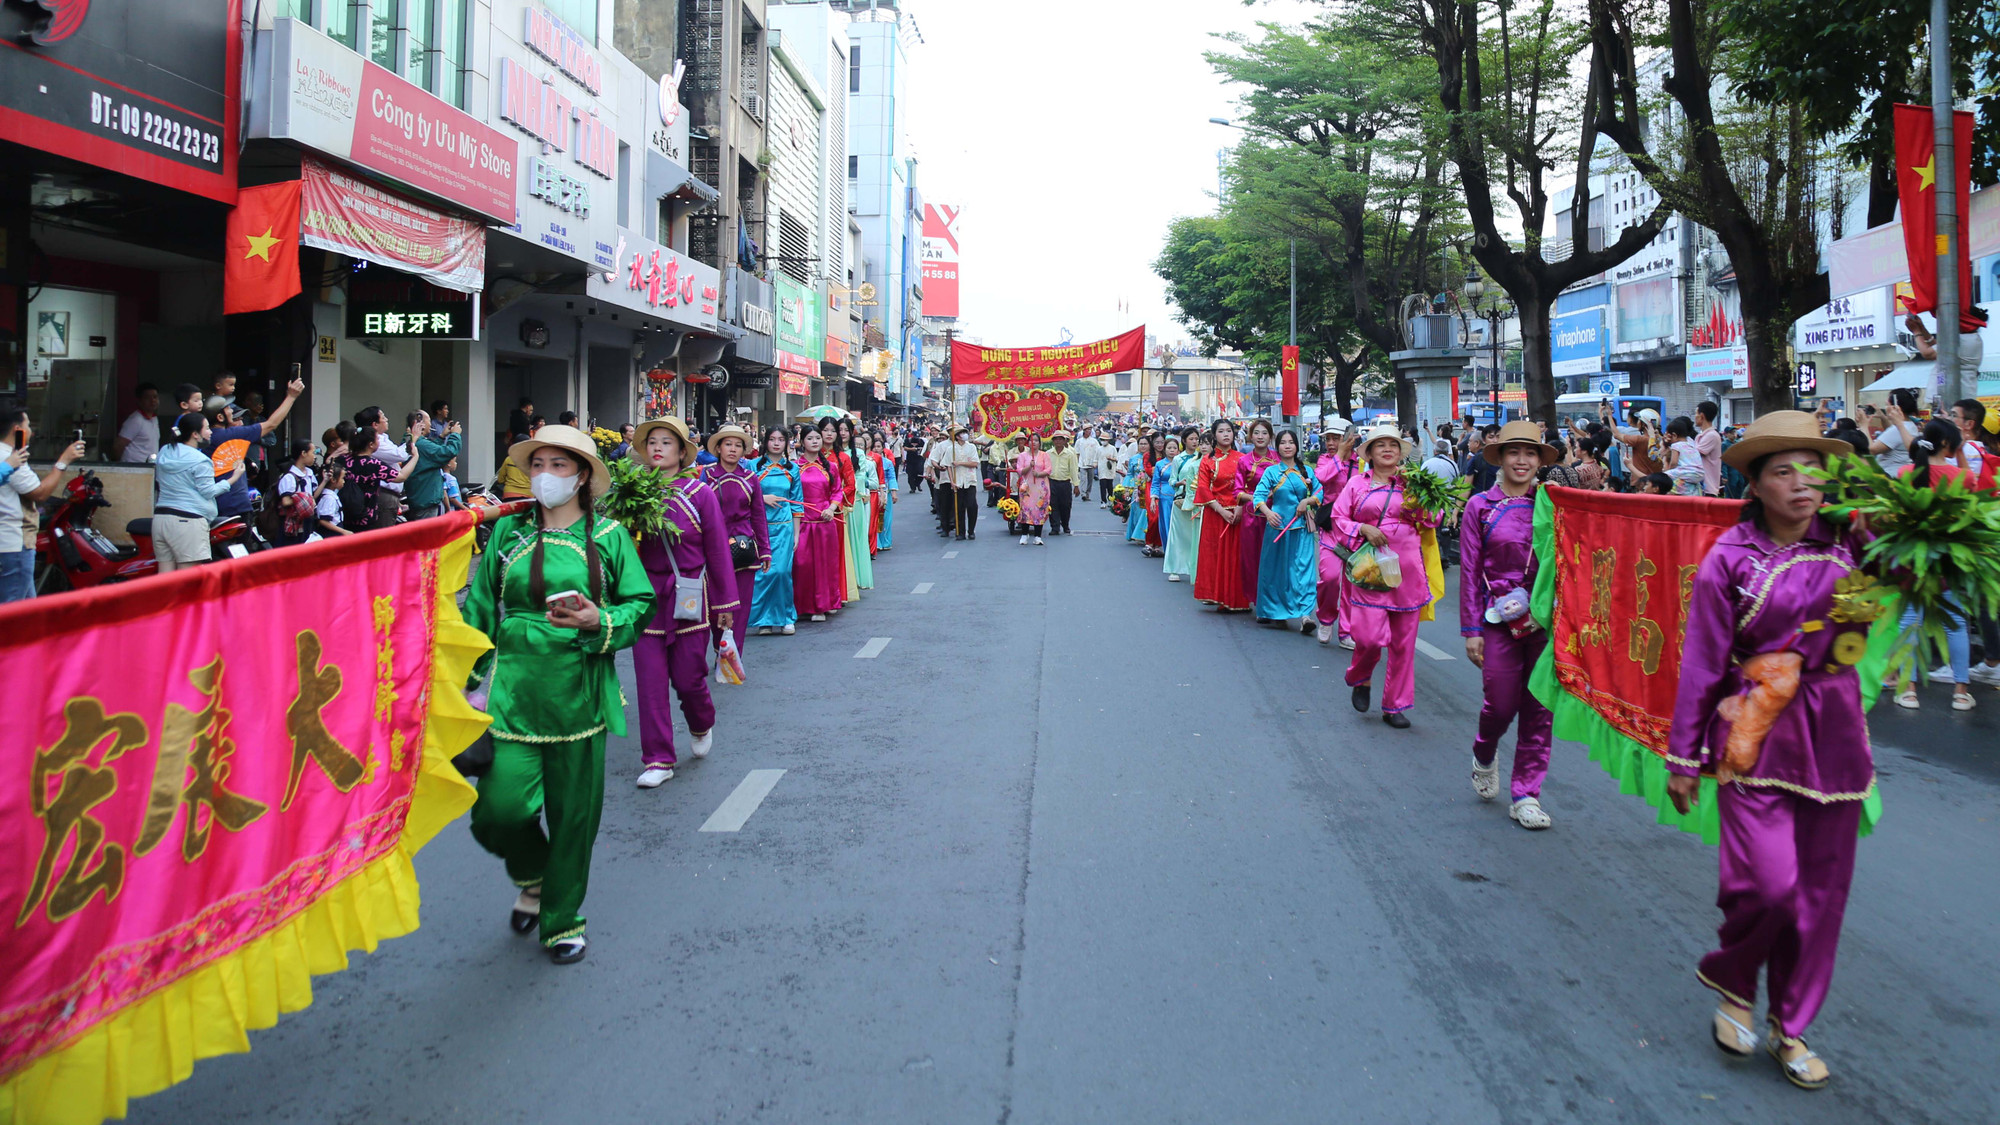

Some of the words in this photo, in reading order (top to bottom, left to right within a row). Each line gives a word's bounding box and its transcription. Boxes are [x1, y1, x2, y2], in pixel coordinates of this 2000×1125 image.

[528, 8, 562, 67] NHA
[563, 37, 600, 96] KHOA
[318, 69, 351, 99] Ribbons
[503, 58, 572, 155] NHẬT
[574, 104, 616, 181] TÂN
[121, 103, 140, 138] 09
[143, 112, 181, 151] 2222
[184, 126, 200, 158] 23
[203, 132, 219, 164] 23
[372, 87, 413, 140] Công
[418, 119, 432, 148] ty
[435, 123, 455, 153] Ưu
[459, 132, 477, 169] Mỹ
[480, 143, 511, 179] Store
[931, 270, 943, 279] 55
[945, 270, 957, 280] 88
[365, 311, 453, 335] 日新牙科
[743, 301, 773, 336] CITIZEN
[321, 337, 335, 355] 34
[1555, 326, 1596, 349] vinaphone
[1805, 329, 1829, 345] XING
[1831, 327, 1844, 342] FU
[1846, 324, 1874, 340] TANG
[1733, 366, 1746, 377] PHÁT
[1734, 354, 1746, 366] TIẾN
